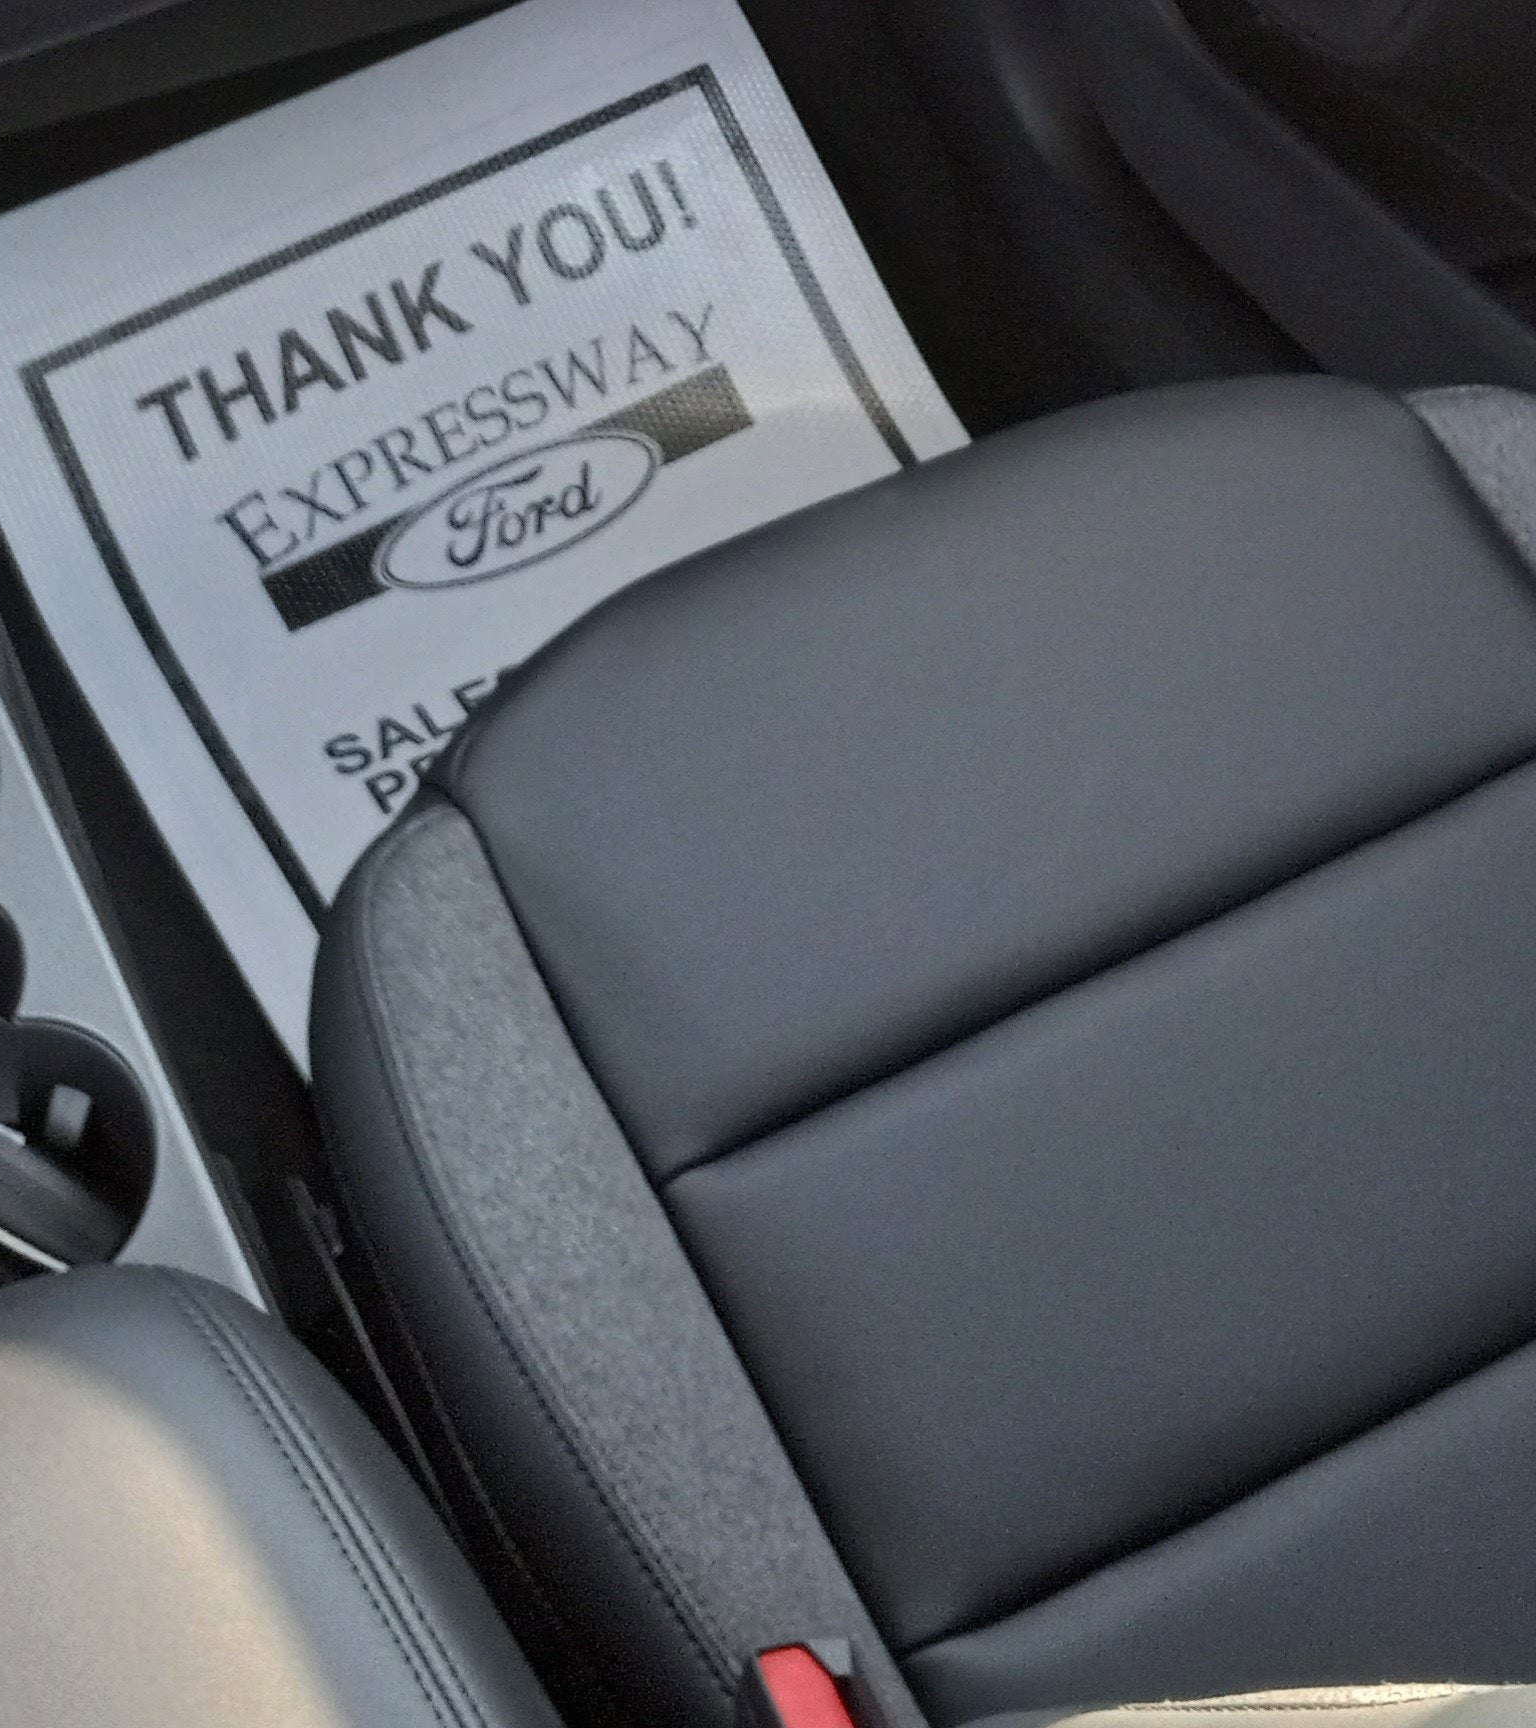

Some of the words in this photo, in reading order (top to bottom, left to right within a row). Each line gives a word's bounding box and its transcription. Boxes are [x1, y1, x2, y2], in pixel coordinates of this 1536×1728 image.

[136, 261, 474, 461] THANK
[470, 159, 699, 308] YOU!
[215, 302, 716, 569] EXPRESSWAY
[445, 461, 602, 569] Ford
